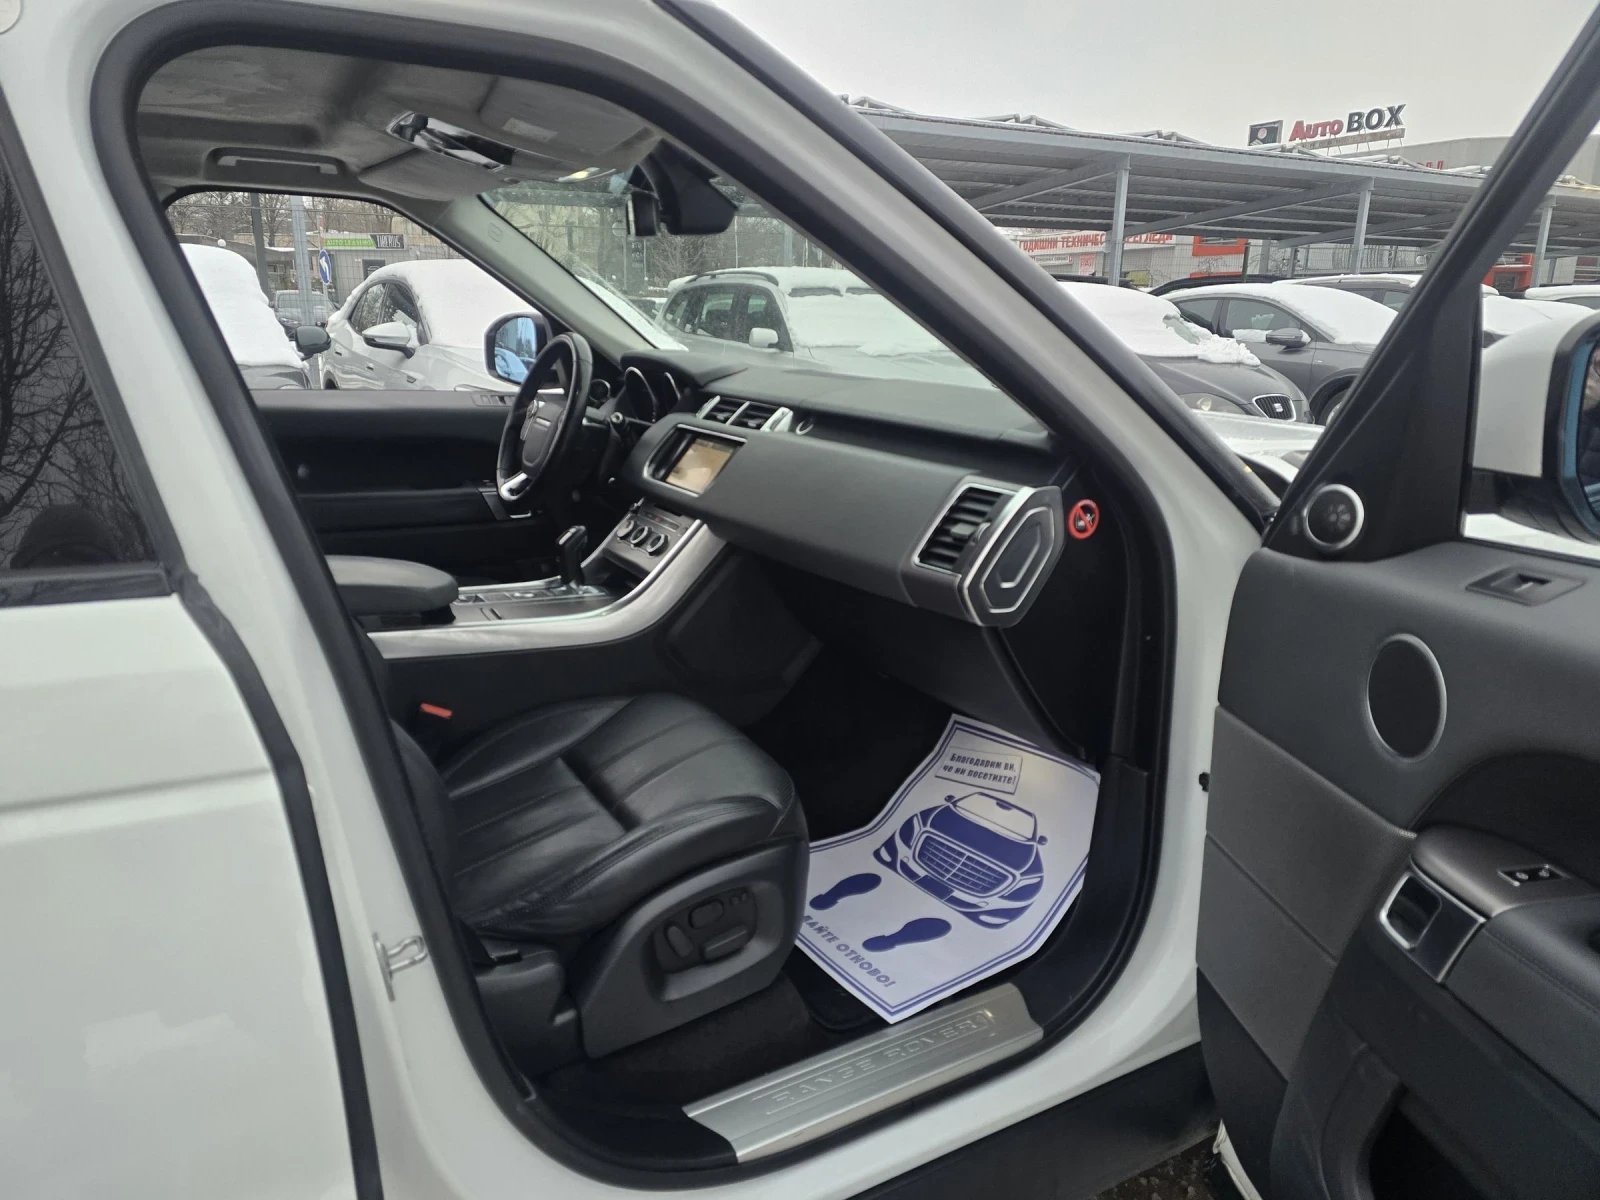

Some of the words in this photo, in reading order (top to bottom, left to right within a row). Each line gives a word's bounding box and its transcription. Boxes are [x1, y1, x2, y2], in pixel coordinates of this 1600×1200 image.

[1347, 103, 1406, 133] BOX
[1019, 238, 1058, 252] ГОДИШНИ
[1061, 232, 1106, 249] ТЕХНИЧЕС
[951, 753, 1002, 769] Благодарим
[942, 764, 954, 773] че
[954, 768, 966, 776] ни
[967, 770, 1017, 785] посетихте!
[836, 943, 896, 987] ОТНОВО!
[771, 1058, 876, 1102] RANGE
[886, 1019, 978, 1060] ROVER
